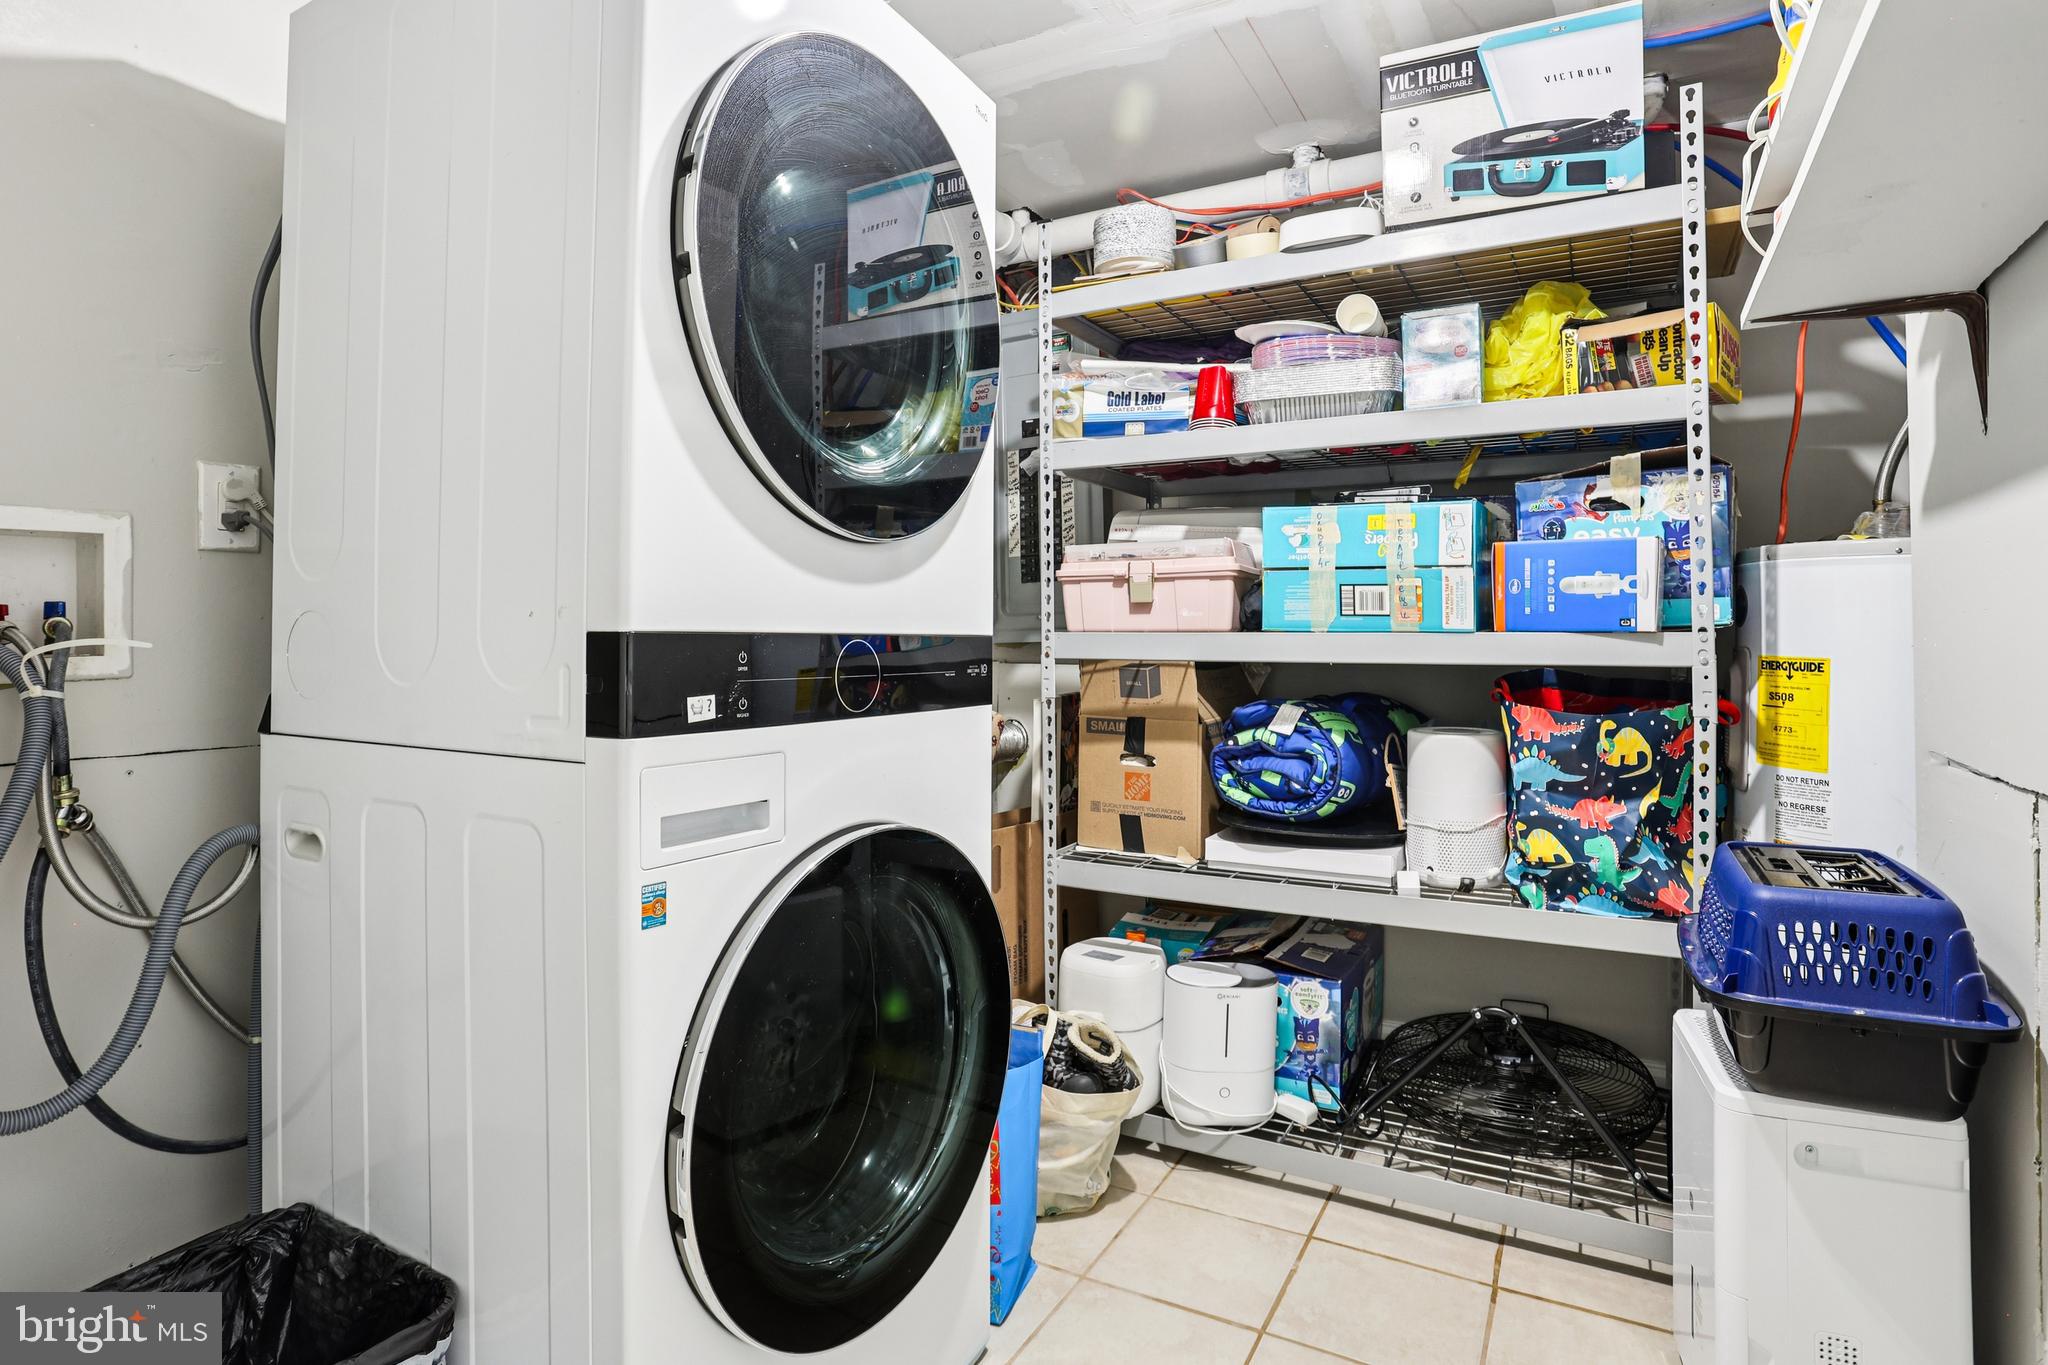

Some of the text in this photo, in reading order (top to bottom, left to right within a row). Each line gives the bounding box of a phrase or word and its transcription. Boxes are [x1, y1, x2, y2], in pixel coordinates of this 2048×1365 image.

[1386, 60, 1474, 93] VICTROLA
[1544, 66, 1611, 83] VICTROLA
[1389, 78, 1473, 101] BLUETOOTH TURNTABLE
[1565, 332, 1572, 347] 32
[1642, 329, 1655, 351] ags
[1658, 327, 1671, 372] ean-Up
[1565, 347, 1573, 369] BAGS
[1673, 323, 1686, 381] ontractor
[1107, 390, 1166, 407] Gold Label
[1364, 529, 1418, 550] Ppers
[1773, 725, 1793, 734] 4773
[1775, 774, 1785, 782] DO
[1800, 777, 1830, 787] RETURN
[1778, 800, 1827, 814] NO REGRESE
